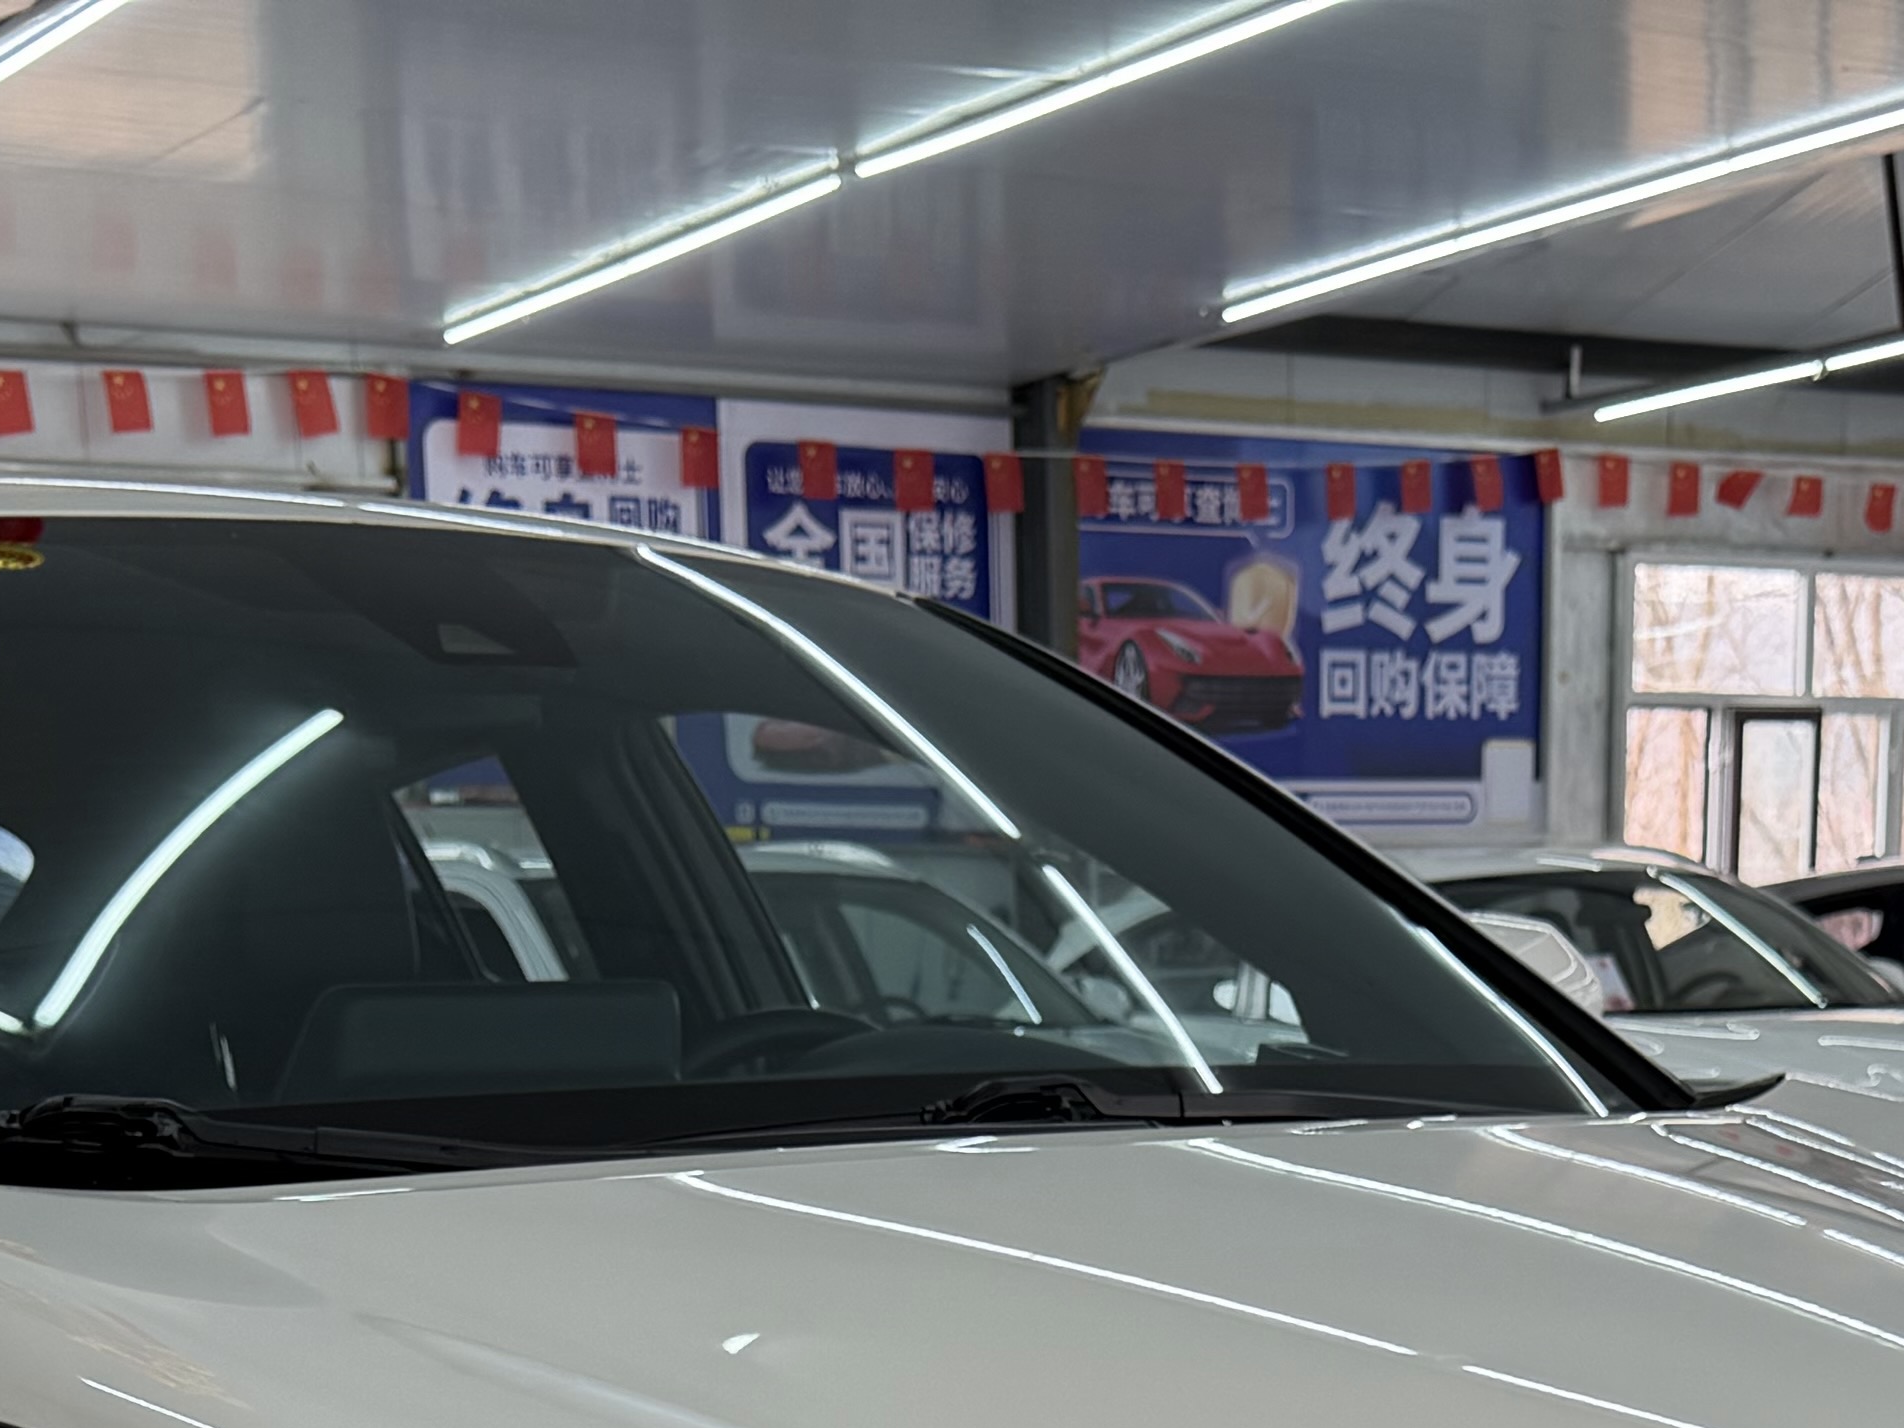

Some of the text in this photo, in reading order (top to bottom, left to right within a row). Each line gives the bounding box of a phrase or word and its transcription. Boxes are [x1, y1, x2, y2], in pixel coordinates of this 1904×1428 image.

[1321, 500, 1521, 644] 终身
[1318, 647, 1520, 721] 回购保障
